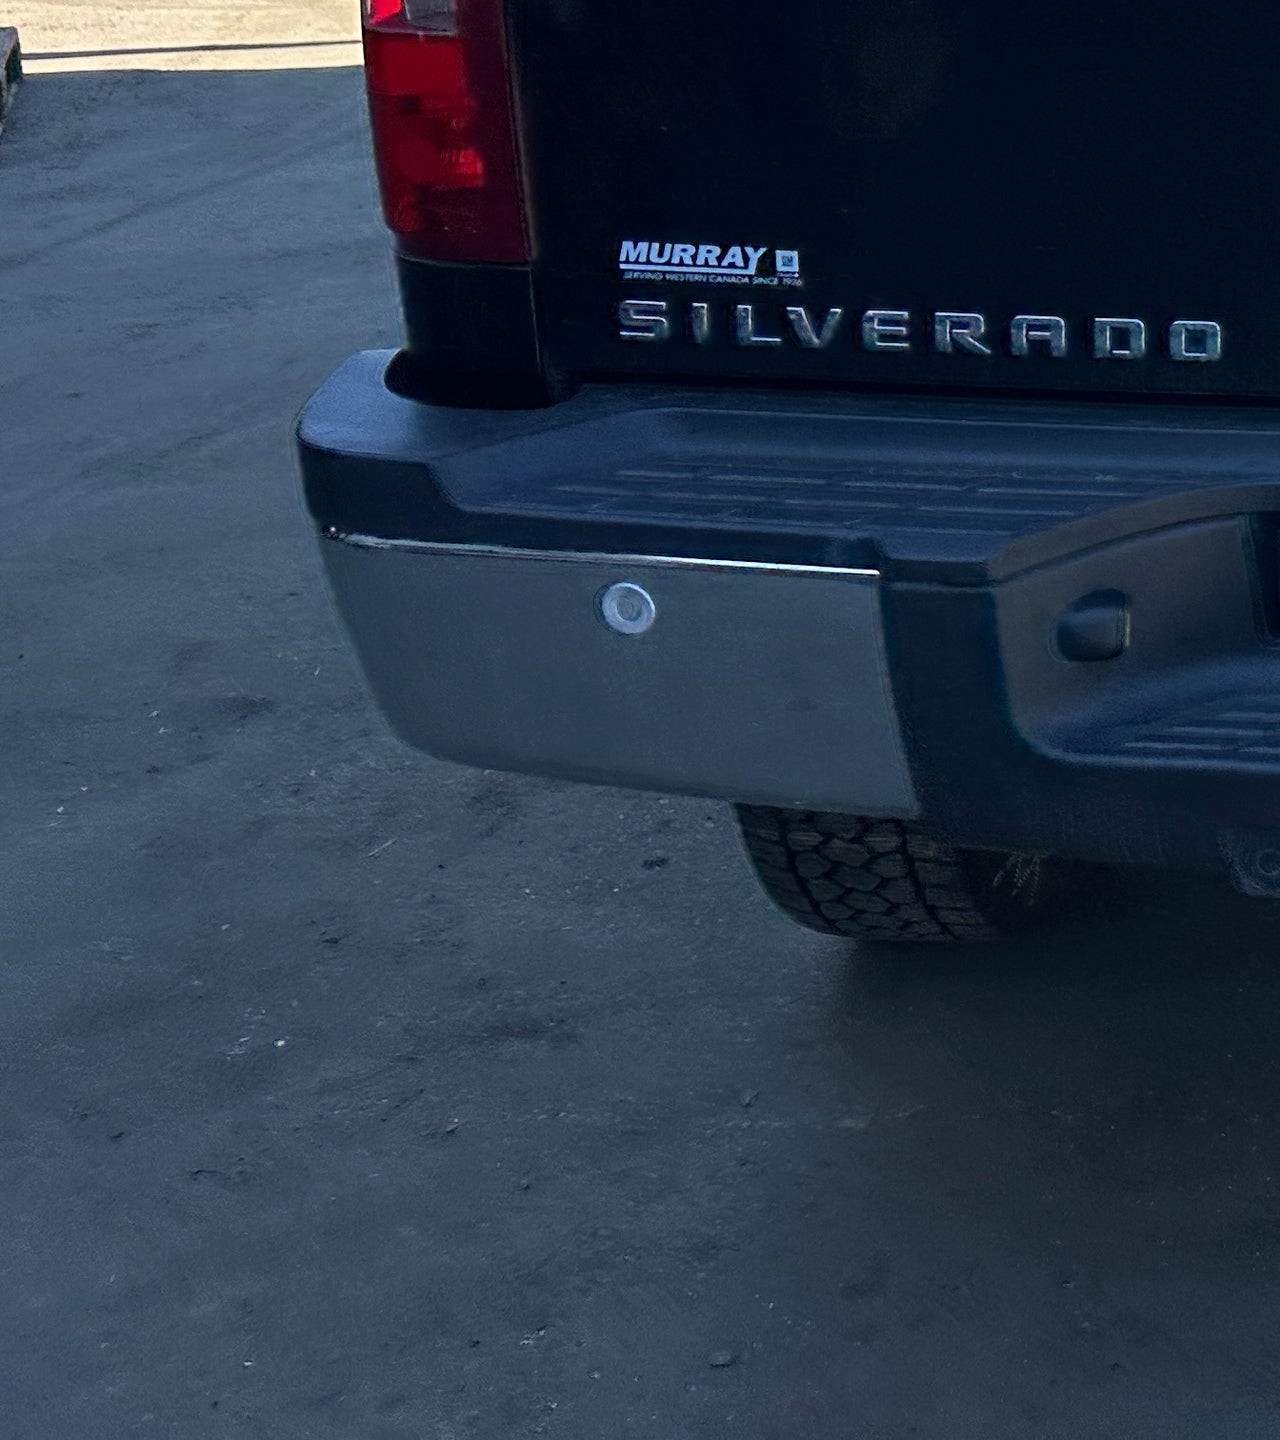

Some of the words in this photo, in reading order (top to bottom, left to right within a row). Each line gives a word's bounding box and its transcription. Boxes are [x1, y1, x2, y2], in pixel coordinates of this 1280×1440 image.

[619, 240, 768, 275] MURRAY
[623, 271, 664, 281] SERVING
[665, 272, 708, 283] WESTERN
[708, 274, 750, 284] CANADA
[752, 276, 779, 286] SINCE
[618, 298, 1223, 361] SILVERADO
